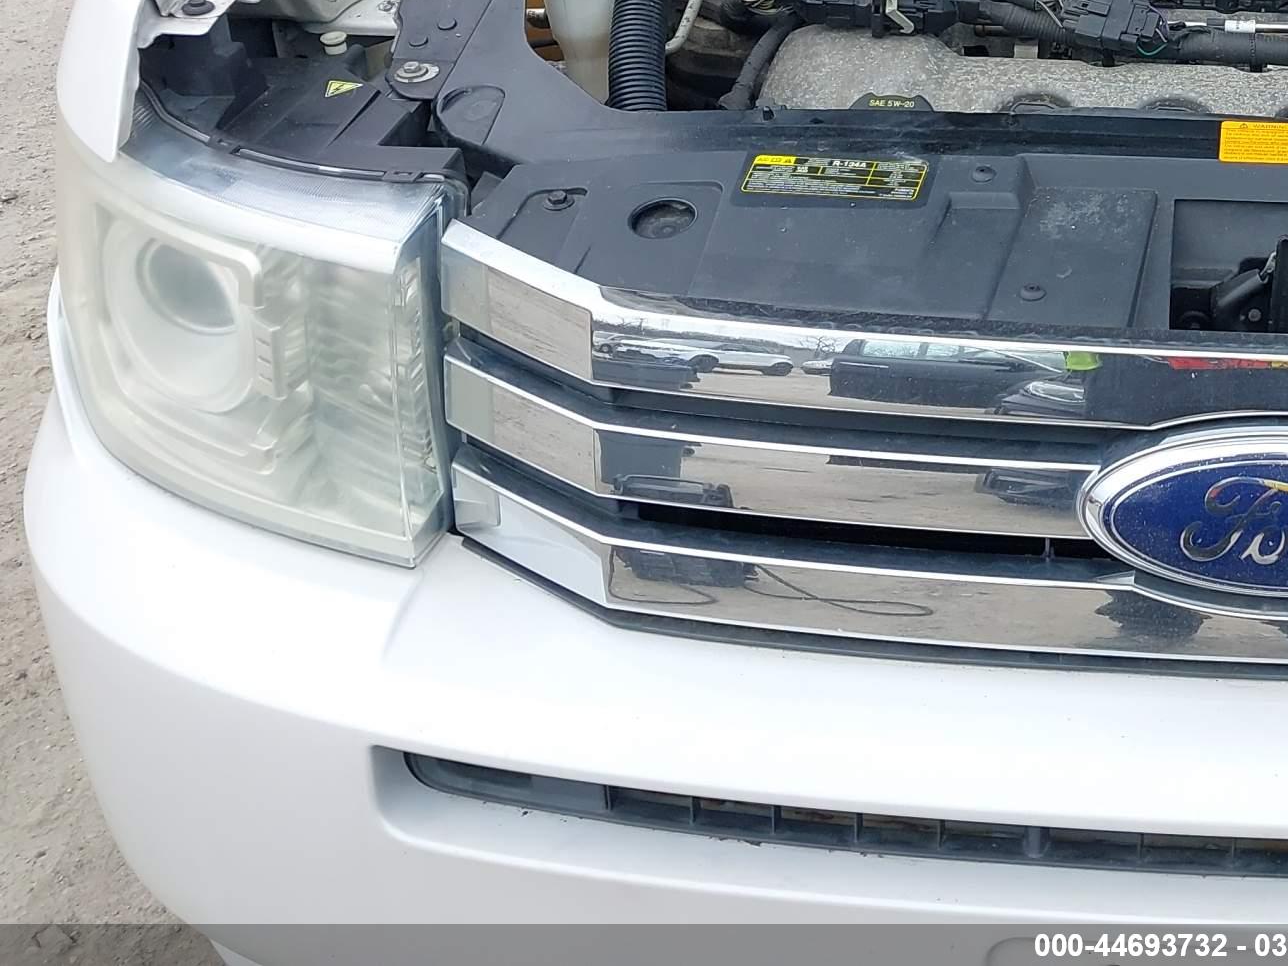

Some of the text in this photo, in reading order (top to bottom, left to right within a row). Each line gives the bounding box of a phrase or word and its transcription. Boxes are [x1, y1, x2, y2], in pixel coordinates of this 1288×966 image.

[869, 99, 915, 108] SAE 5W-20
[832, 160, 867, 168] R-134A
